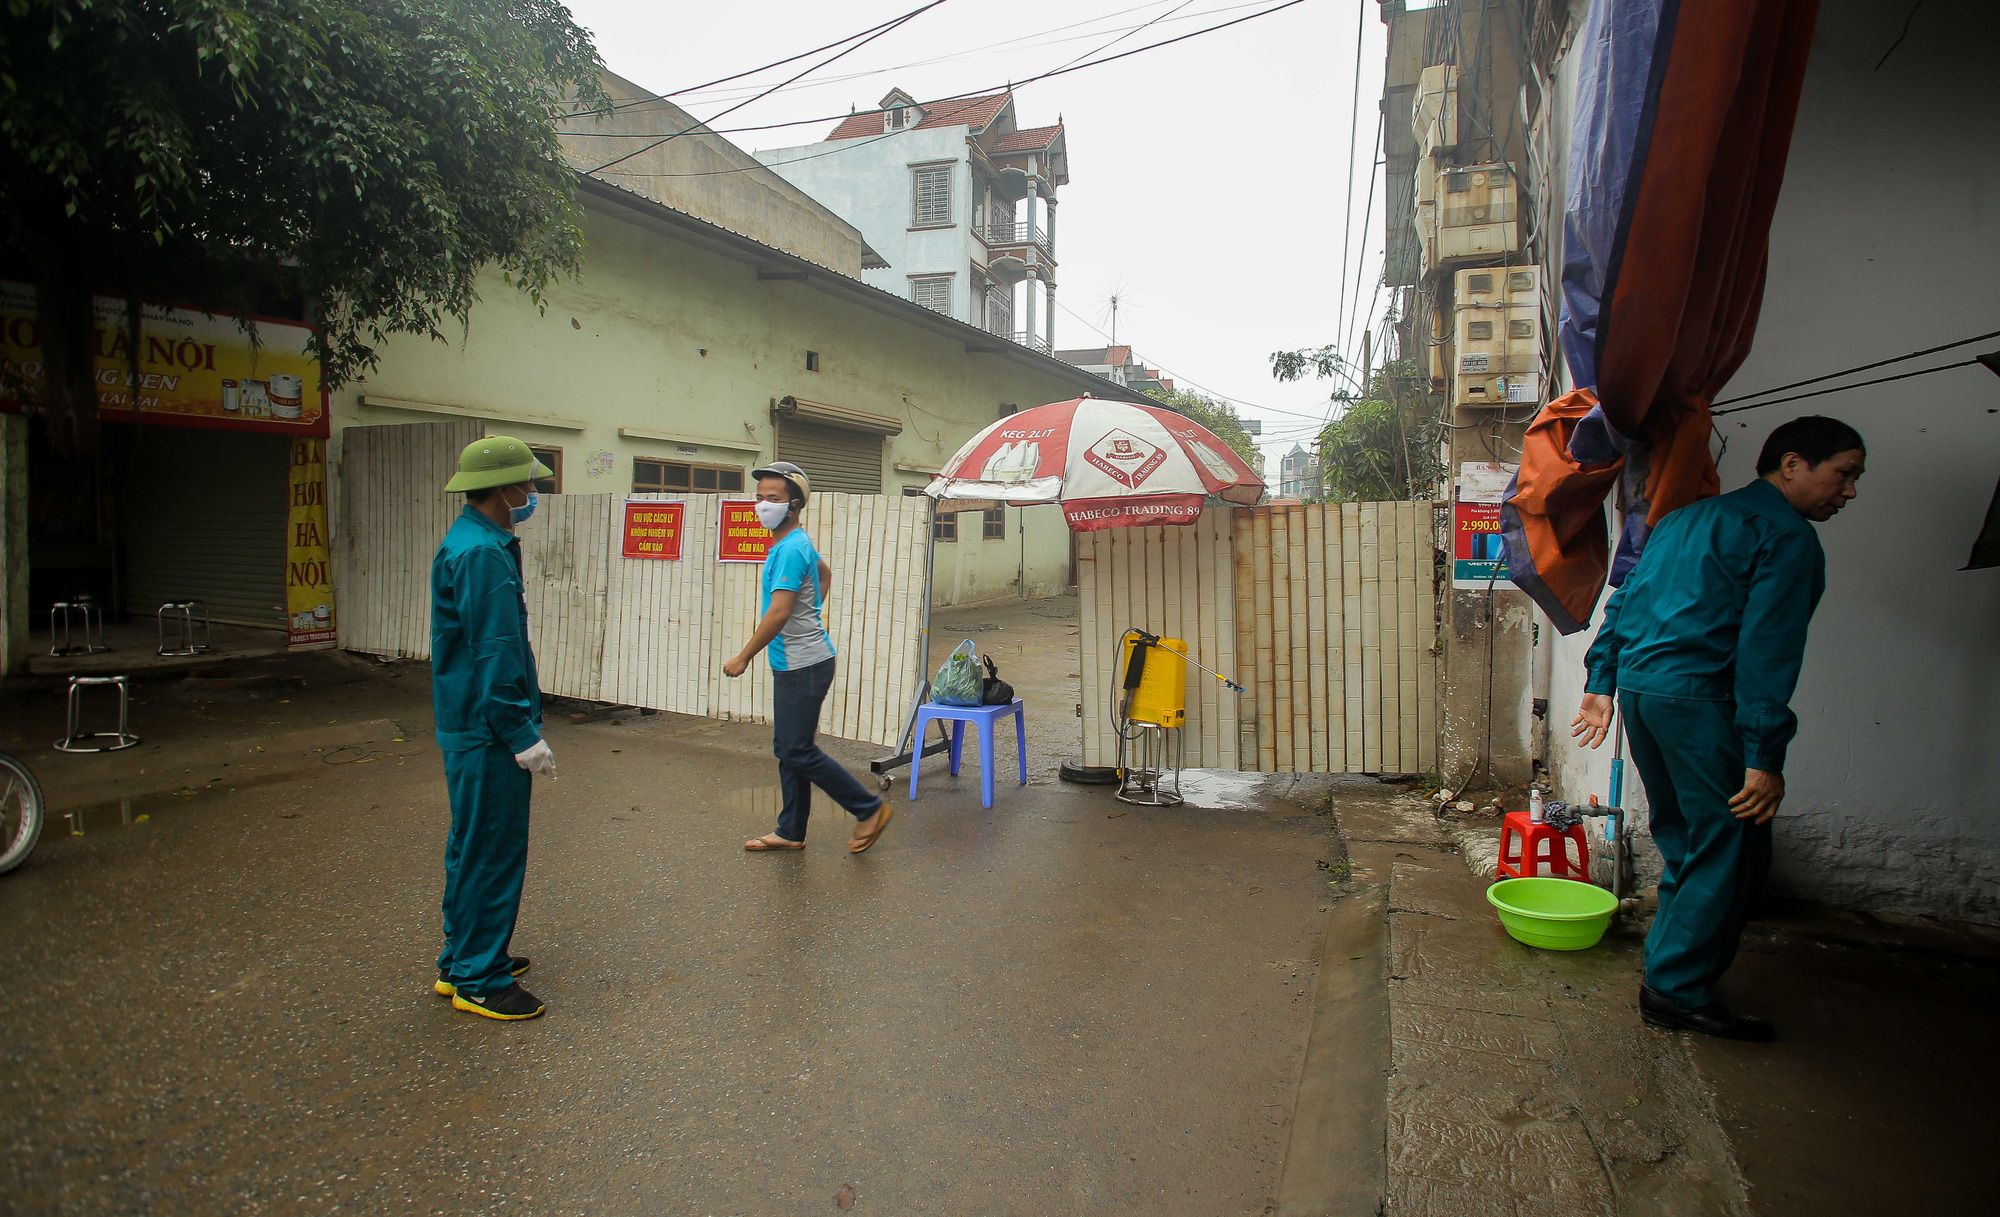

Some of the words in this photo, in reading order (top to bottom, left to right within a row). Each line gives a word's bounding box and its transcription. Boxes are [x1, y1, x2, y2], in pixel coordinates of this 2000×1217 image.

[146, 336, 216, 372] NỘI
[1000, 429, 1026, 439] KEG
[1027, 428, 1056, 439] 2LIT
[294, 439, 321, 466] BA
[1092, 457, 1124, 480] HABECO
[1135, 459, 1157, 481] TRADING
[1069, 507, 1120, 521] HABECO
[1123, 504, 1183, 516] TRADING
[1187, 506, 1200, 516] 89
[294, 518, 321, 548] HÀ
[630, 527, 647, 537] KHÔNG
[727, 526, 748, 537] KHÔNG
[1461, 520, 1501, 531] 2.990.0
[737, 540, 752, 553] CẤM
[289, 557, 328, 589] NỘI
